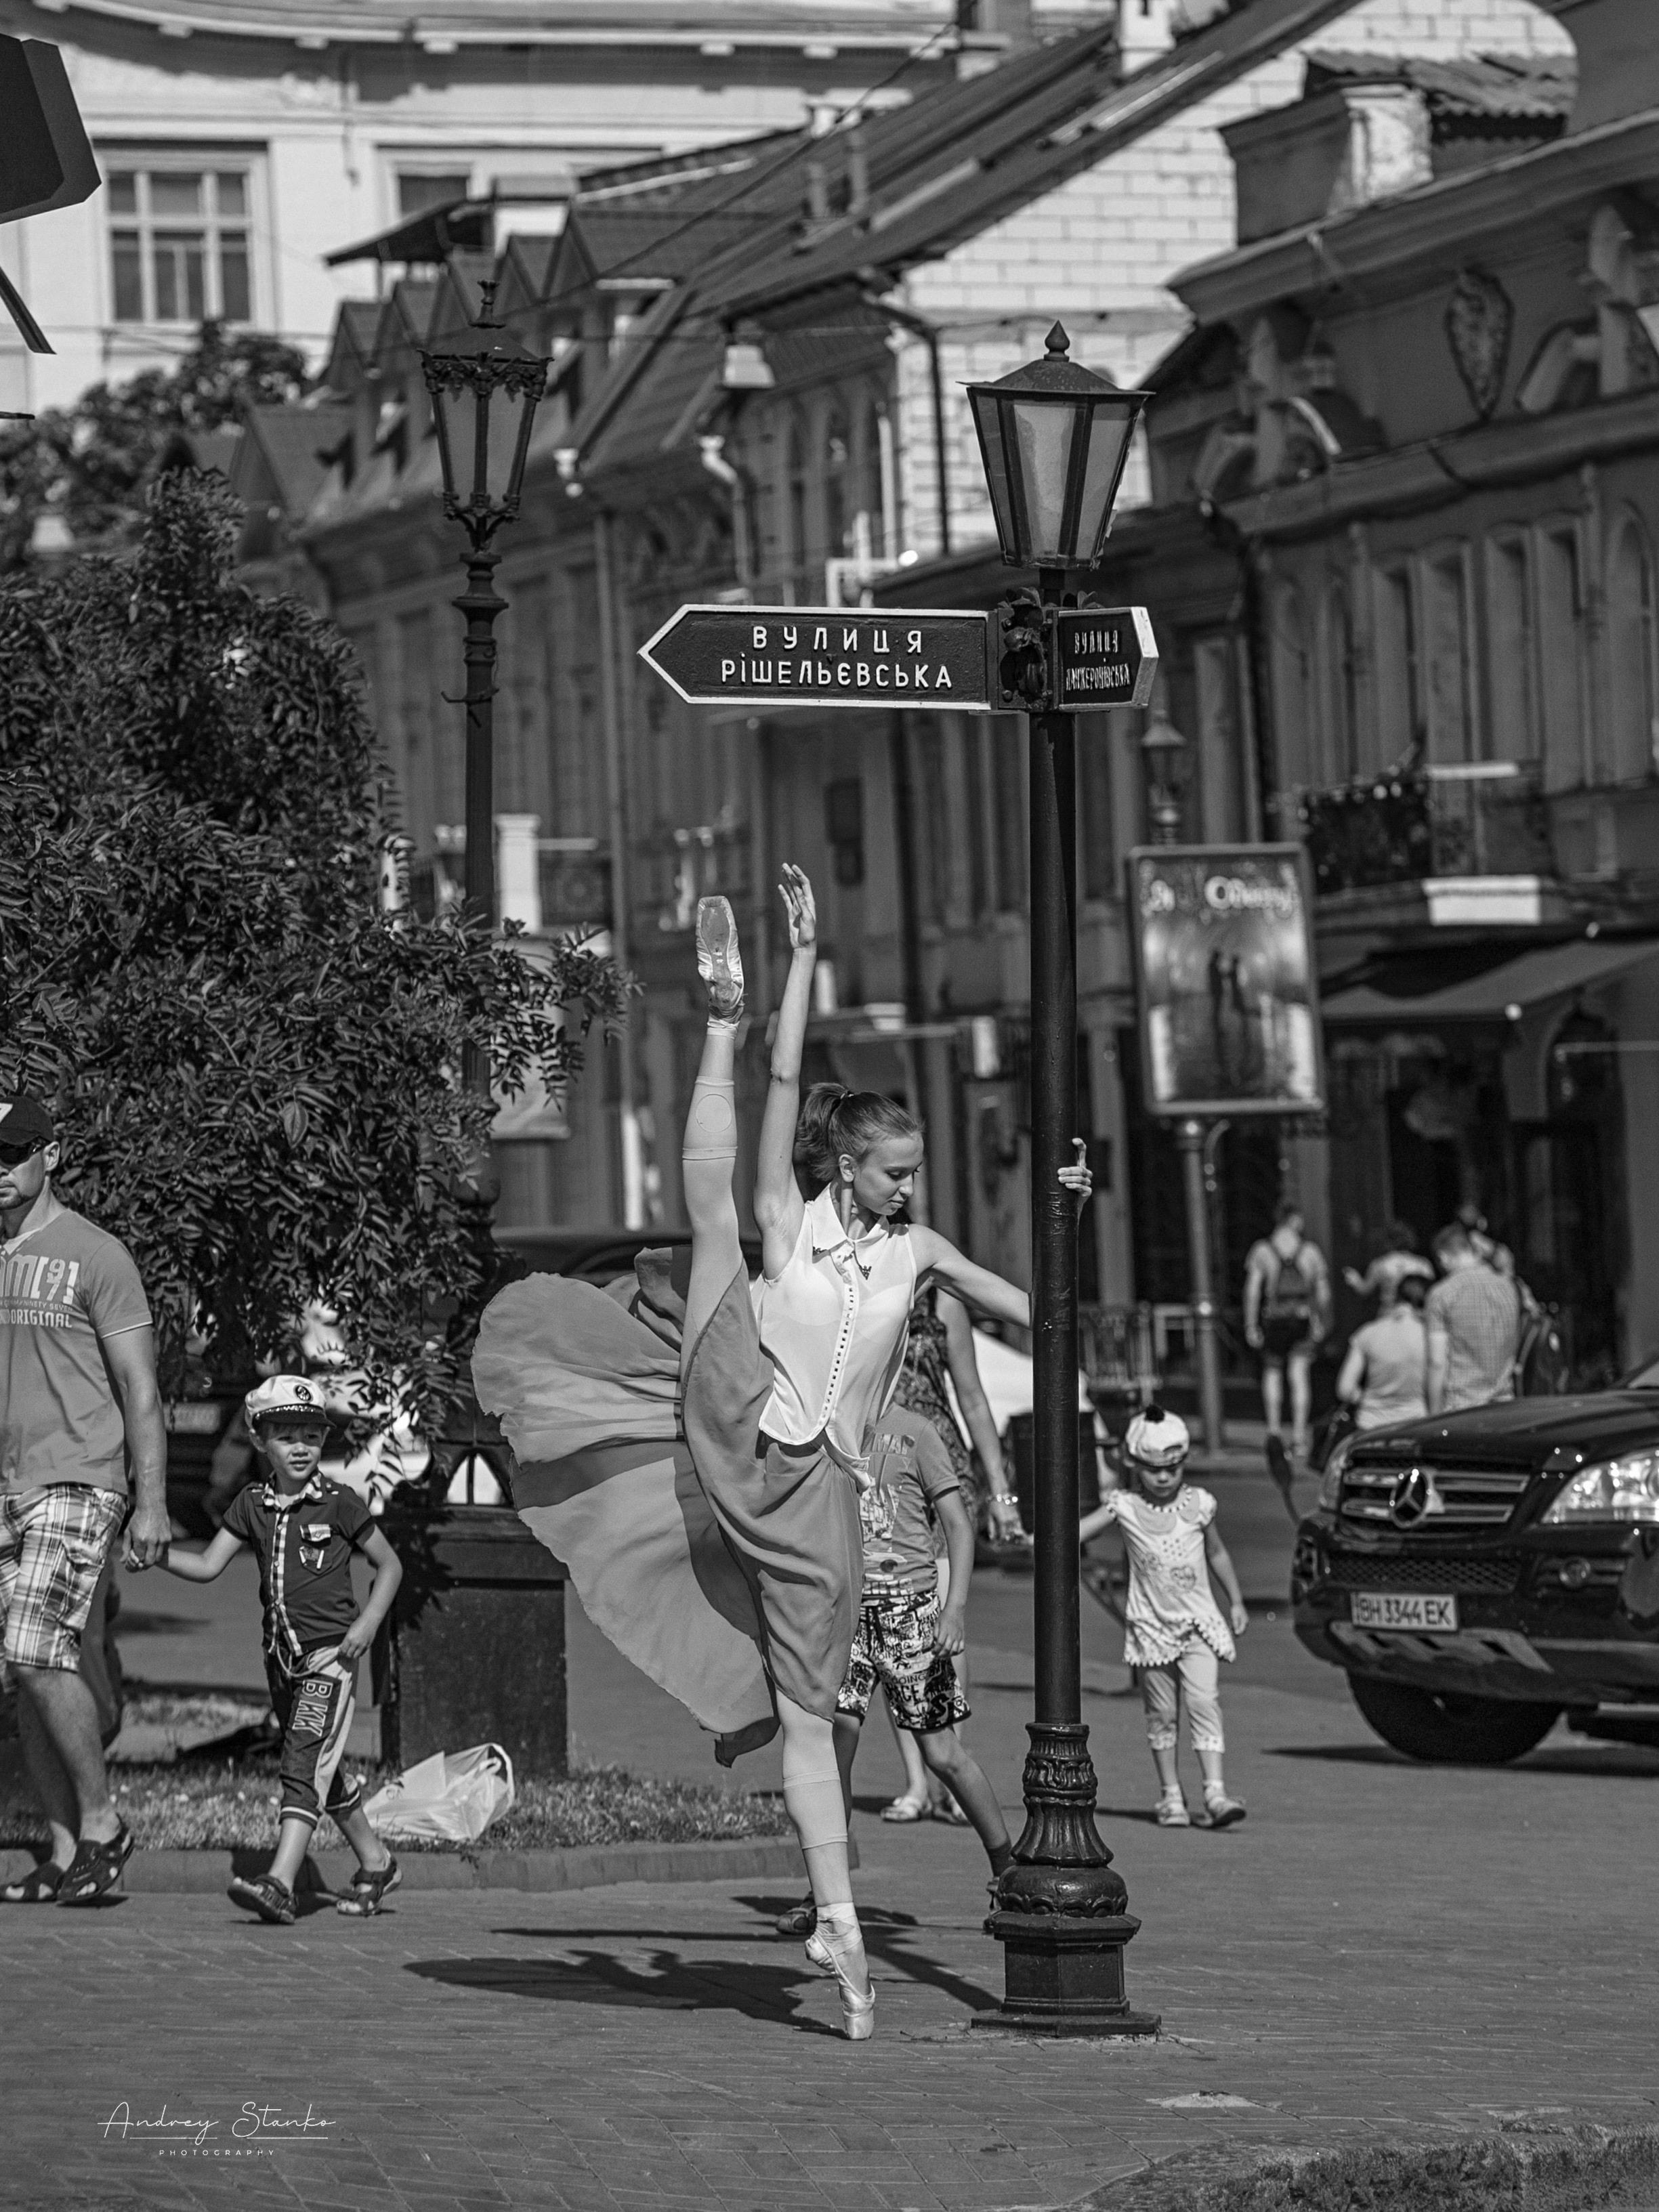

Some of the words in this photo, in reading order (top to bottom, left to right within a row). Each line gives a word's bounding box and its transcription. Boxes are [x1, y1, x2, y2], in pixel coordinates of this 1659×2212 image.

[753, 625, 923, 654] ВУЛИЦЯ
[1074, 630, 1118, 654] ВУЛИЦЯ
[11, 1309, 72, 1328] ORIGINAL
[1425, 1600, 1452, 1625] EK
[292, 1680, 333, 1737] BKK
